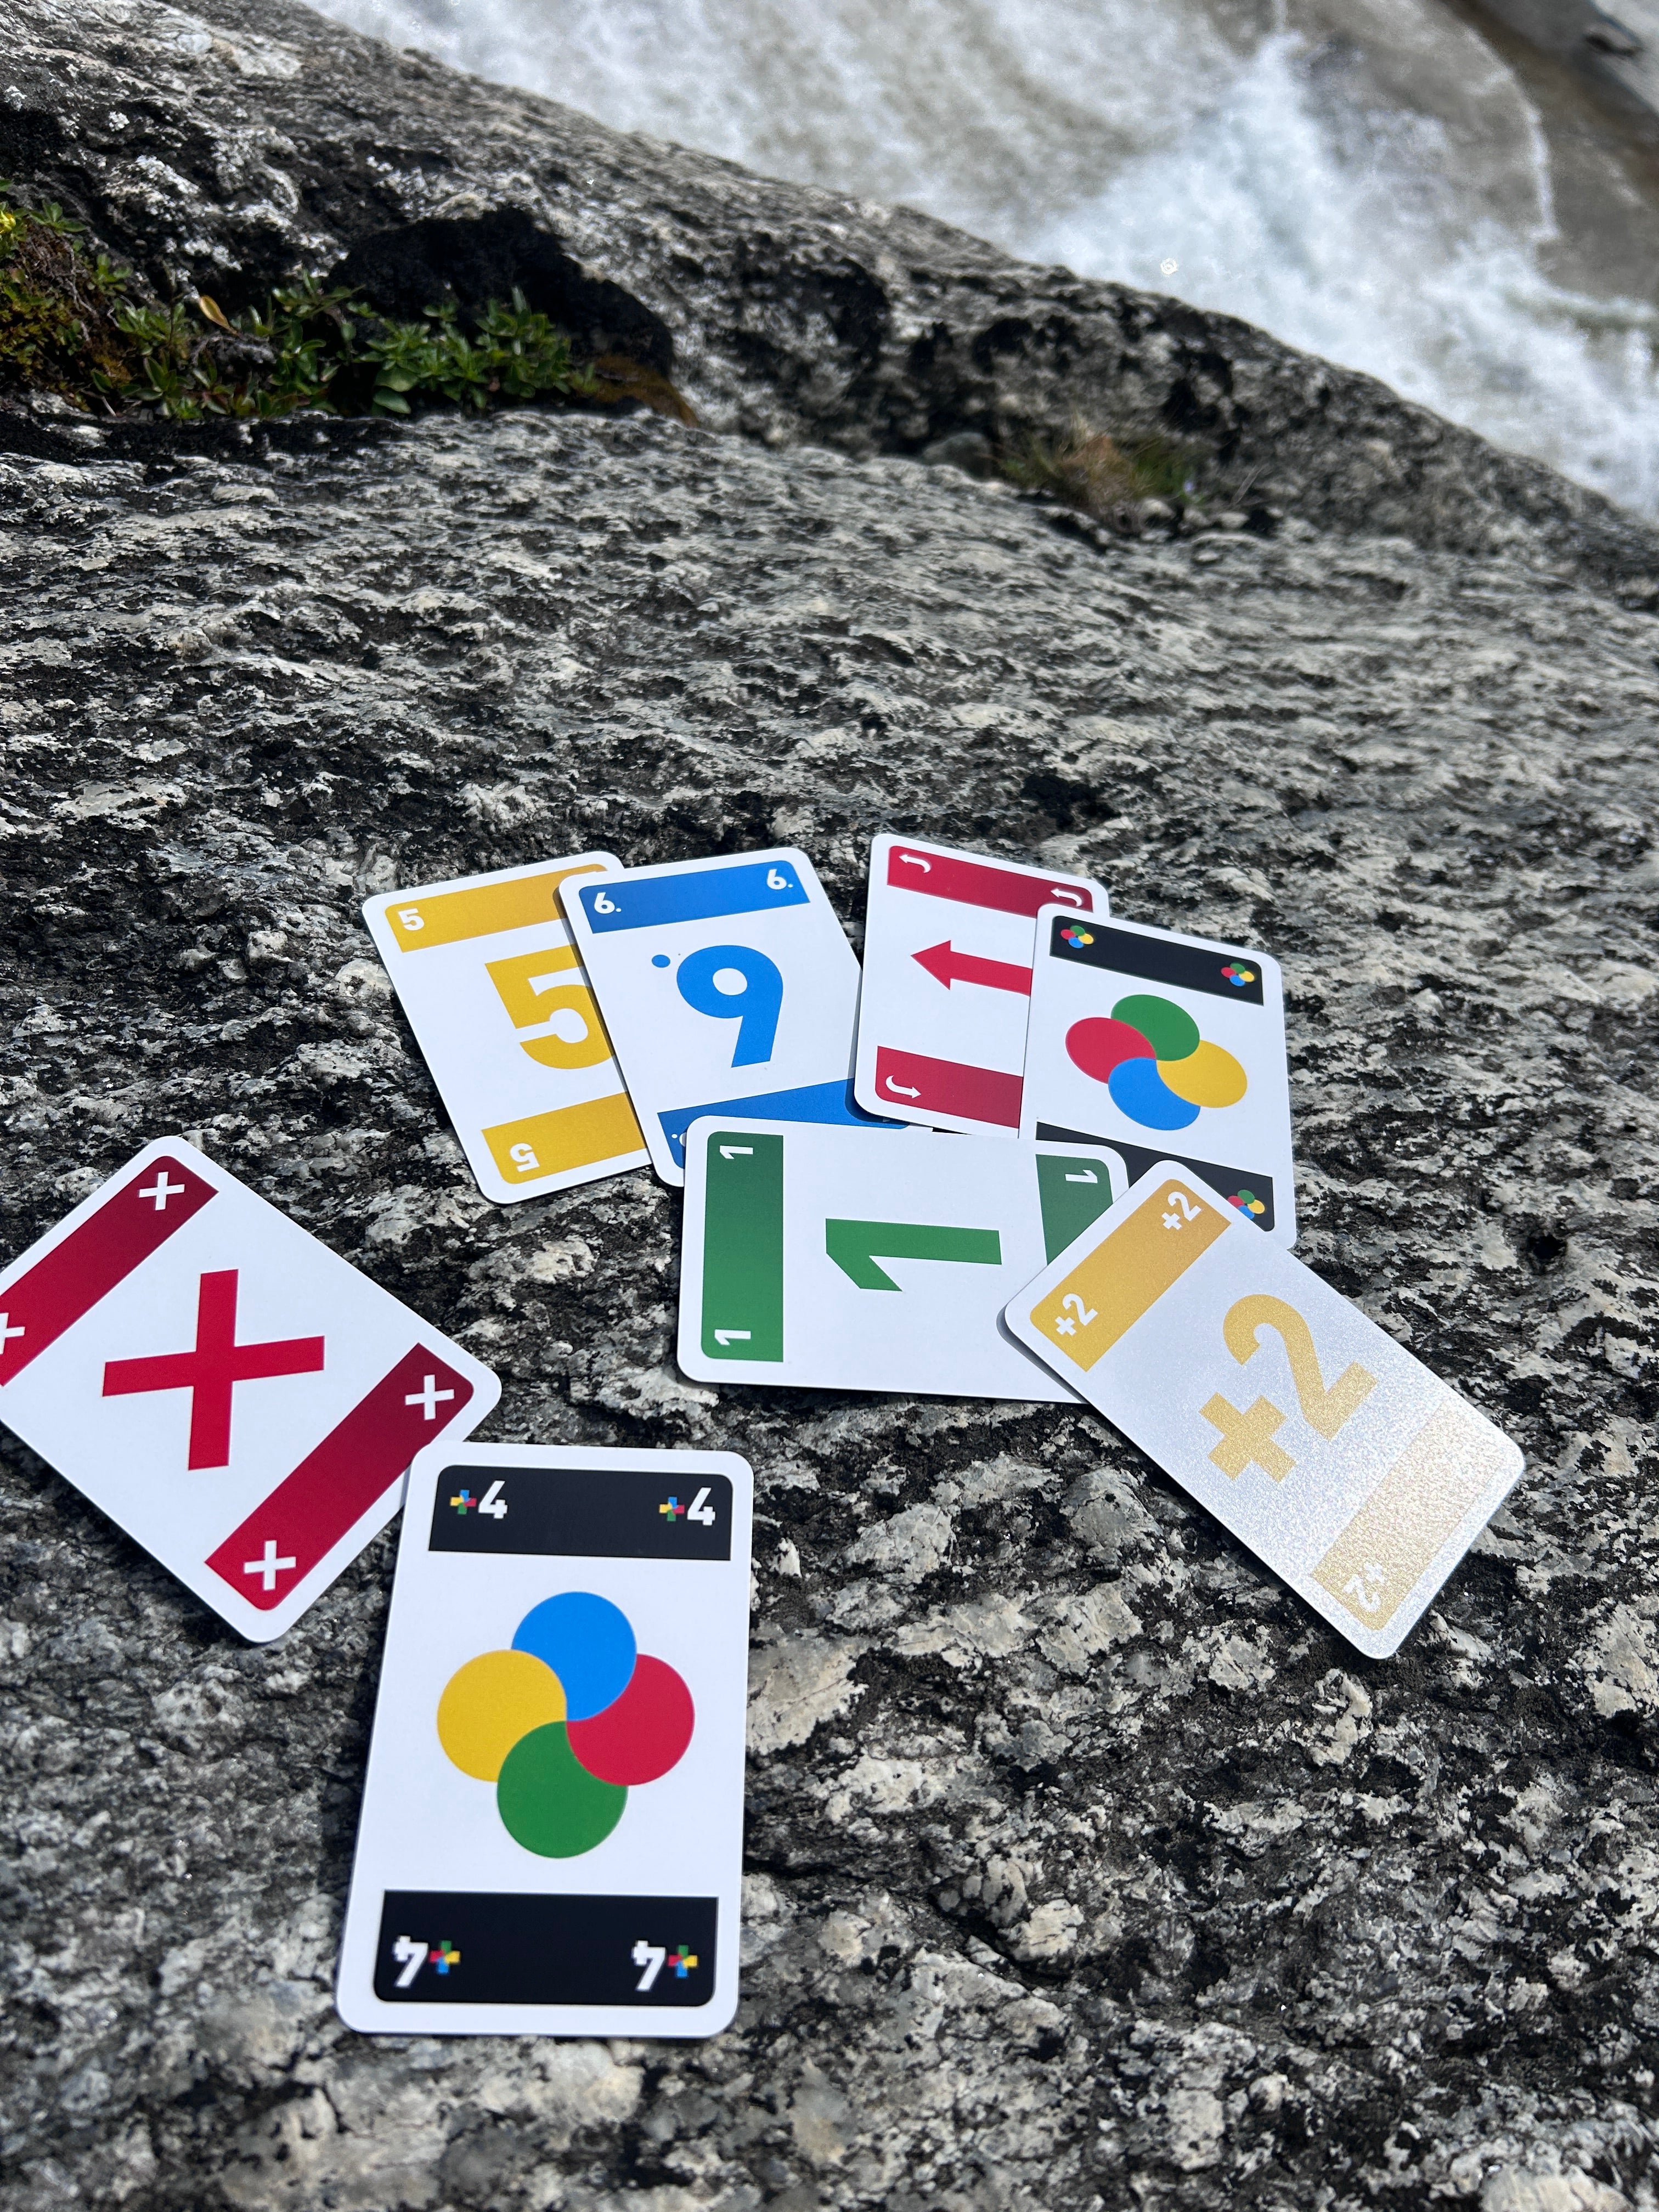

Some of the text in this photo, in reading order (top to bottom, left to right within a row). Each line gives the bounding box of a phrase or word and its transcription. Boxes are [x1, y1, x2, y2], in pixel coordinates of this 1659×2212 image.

[767, 869, 793, 890] 6.
[398, 908, 425, 931] 5
[594, 892, 622, 914] 6.
[486, 944, 615, 1069] 5
[510, 1143, 540, 1172] 5
[719, 1145, 754, 1159] 1
[1065, 1169, 1098, 1184] 1
[1161, 1191, 1204, 1231] +2
[826, 1218, 1002, 1291] 1
[1055, 1293, 1098, 1336] +2
[714, 1329, 752, 1346] 1
[1198, 1294, 1378, 1483] +2
[450, 1480, 508, 1520] +4
[658, 1487, 716, 1526] +4
[393, 1936, 460, 1988] +4
[631, 1940, 698, 1991] +4
